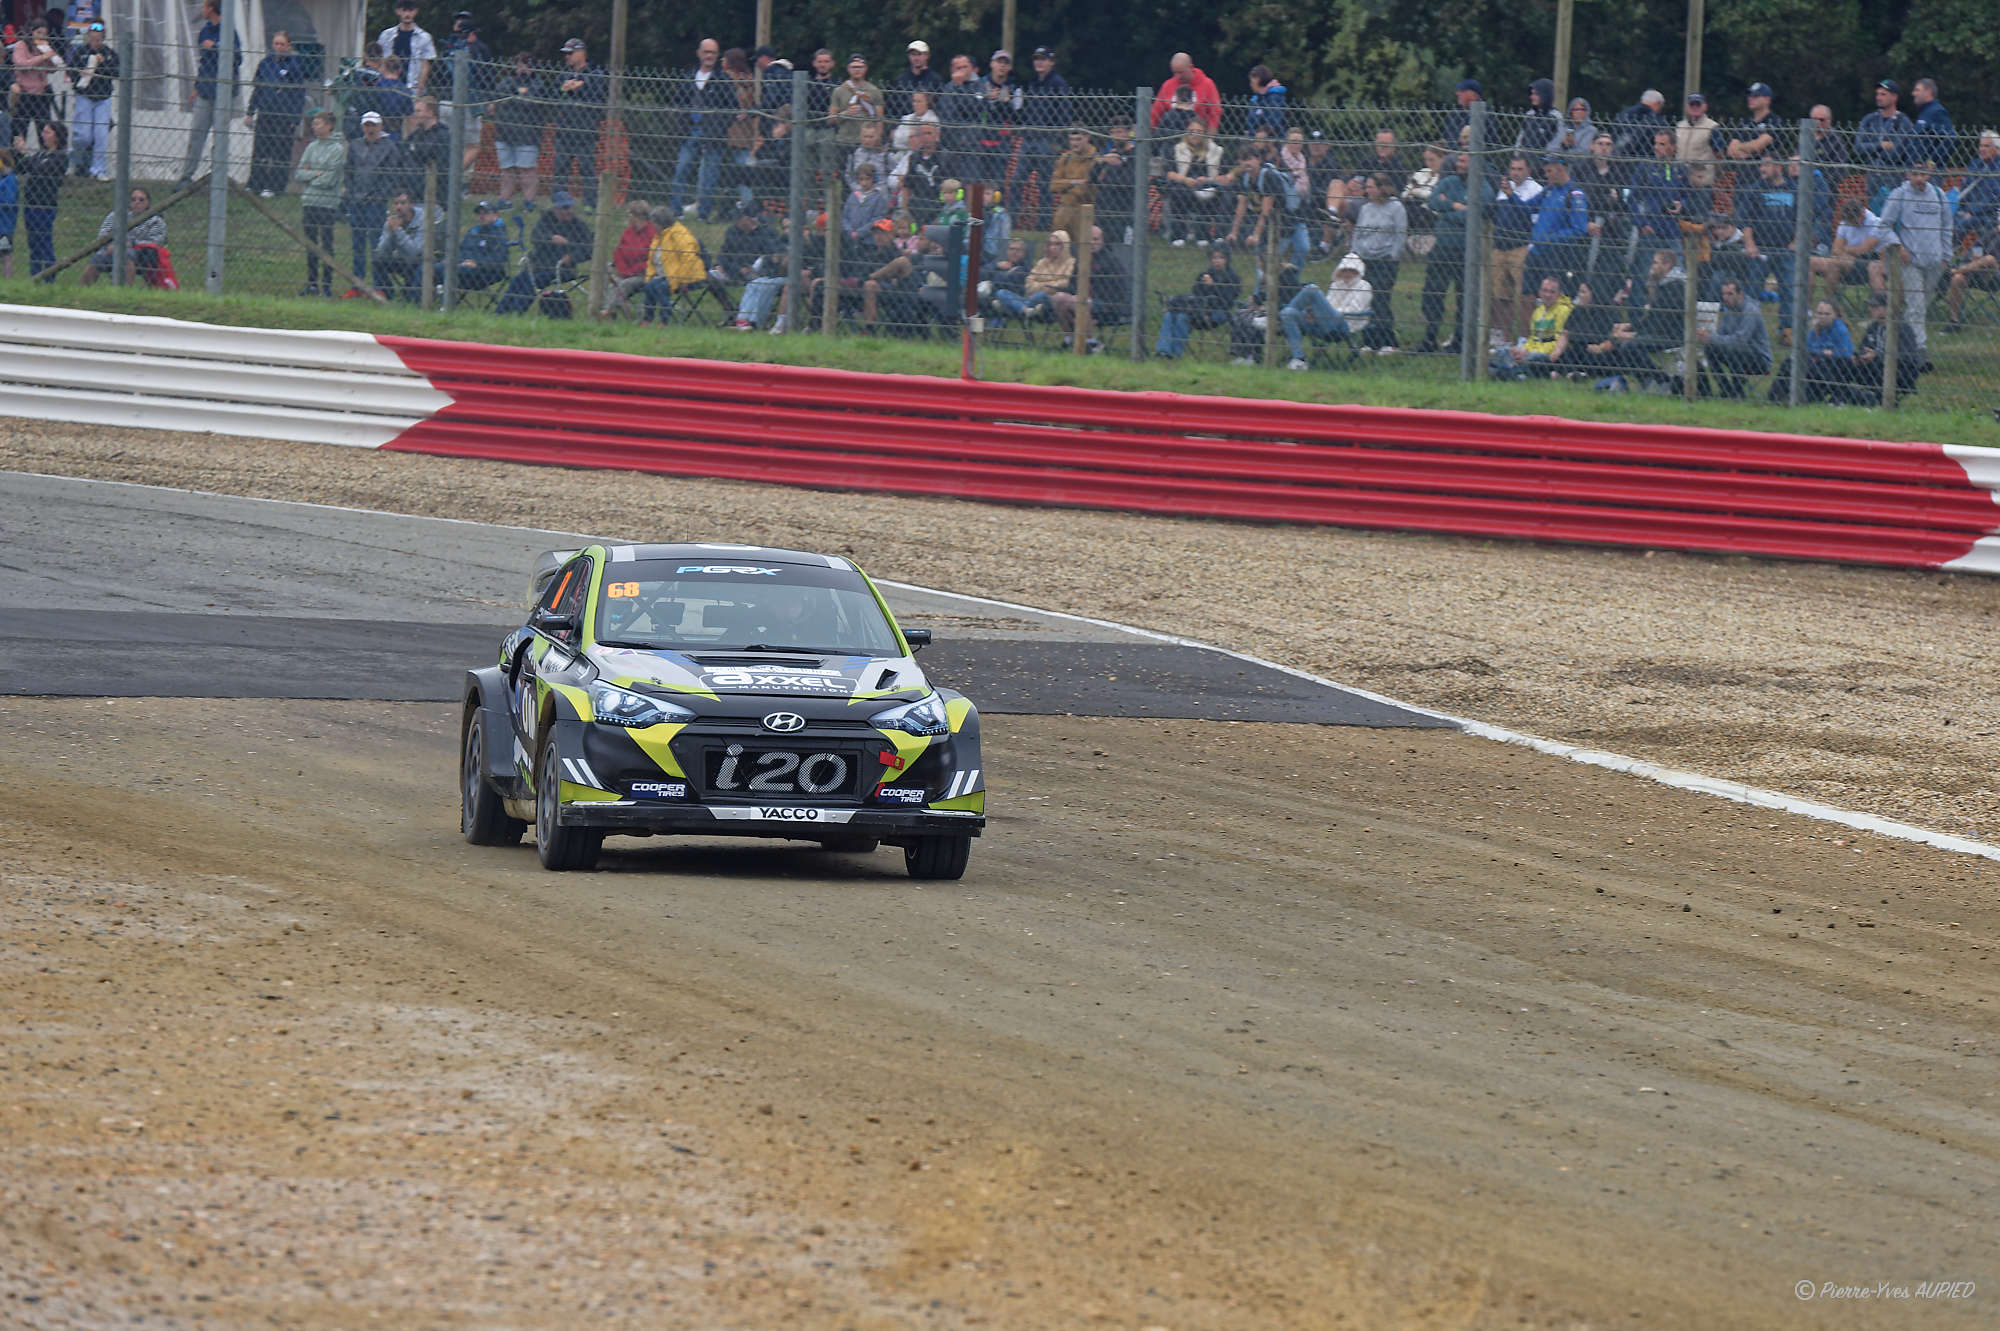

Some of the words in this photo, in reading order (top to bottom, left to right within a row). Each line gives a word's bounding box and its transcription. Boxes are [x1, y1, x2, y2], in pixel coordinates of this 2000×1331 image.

[676, 565, 783, 576] PGRX
[607, 581, 640, 599] 68
[738, 685, 848, 694] MANUTENTION
[715, 743, 848, 794] i20
[631, 783, 686, 791] COOPER
[880, 788, 925, 797] COOPER
[759, 807, 819, 820] YACCO
